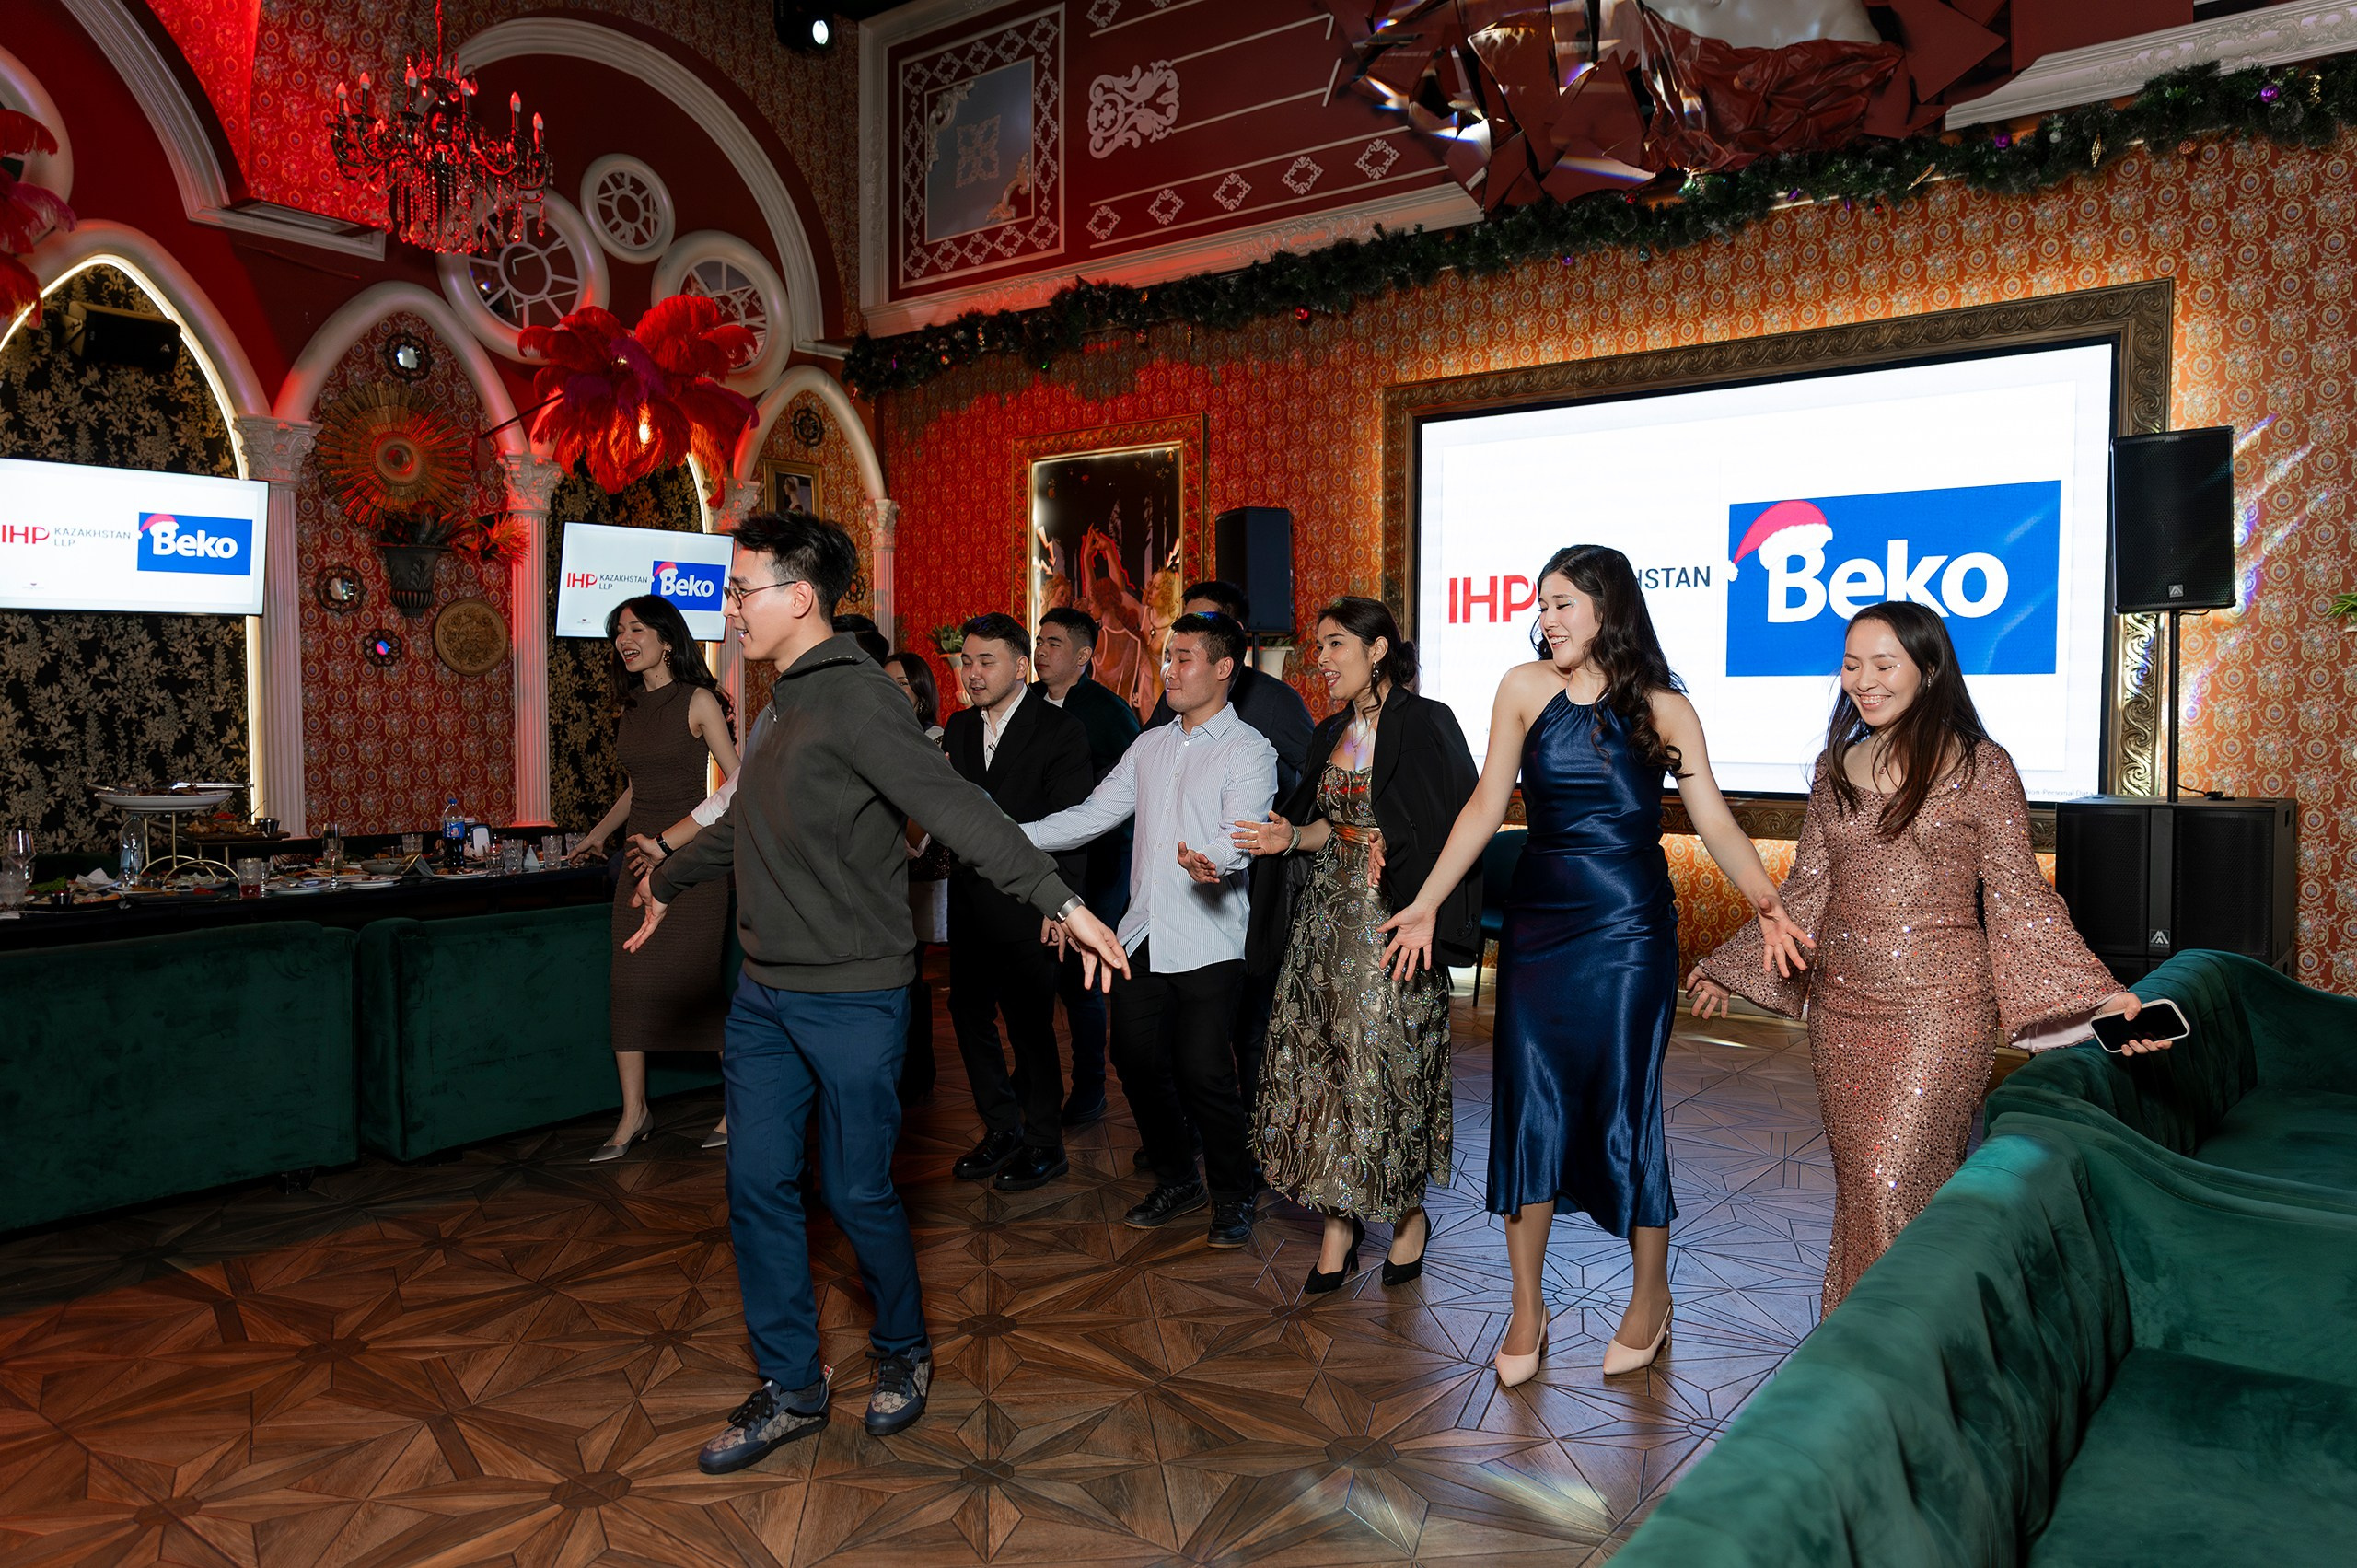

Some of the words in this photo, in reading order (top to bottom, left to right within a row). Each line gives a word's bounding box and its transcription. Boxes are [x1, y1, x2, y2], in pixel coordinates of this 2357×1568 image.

[2, 525, 50, 544] IHP
[54, 527, 131, 540] KAZAKHSTAN
[54, 539, 75, 547] LLP
[153, 529, 238, 559] Beko
[566, 572, 598, 588] IHP
[599, 574, 648, 584] KAZAKHSTAN
[660, 573, 714, 598] Beko
[1767, 539, 2009, 623] Beko
[1448, 575, 1537, 623] IHP
